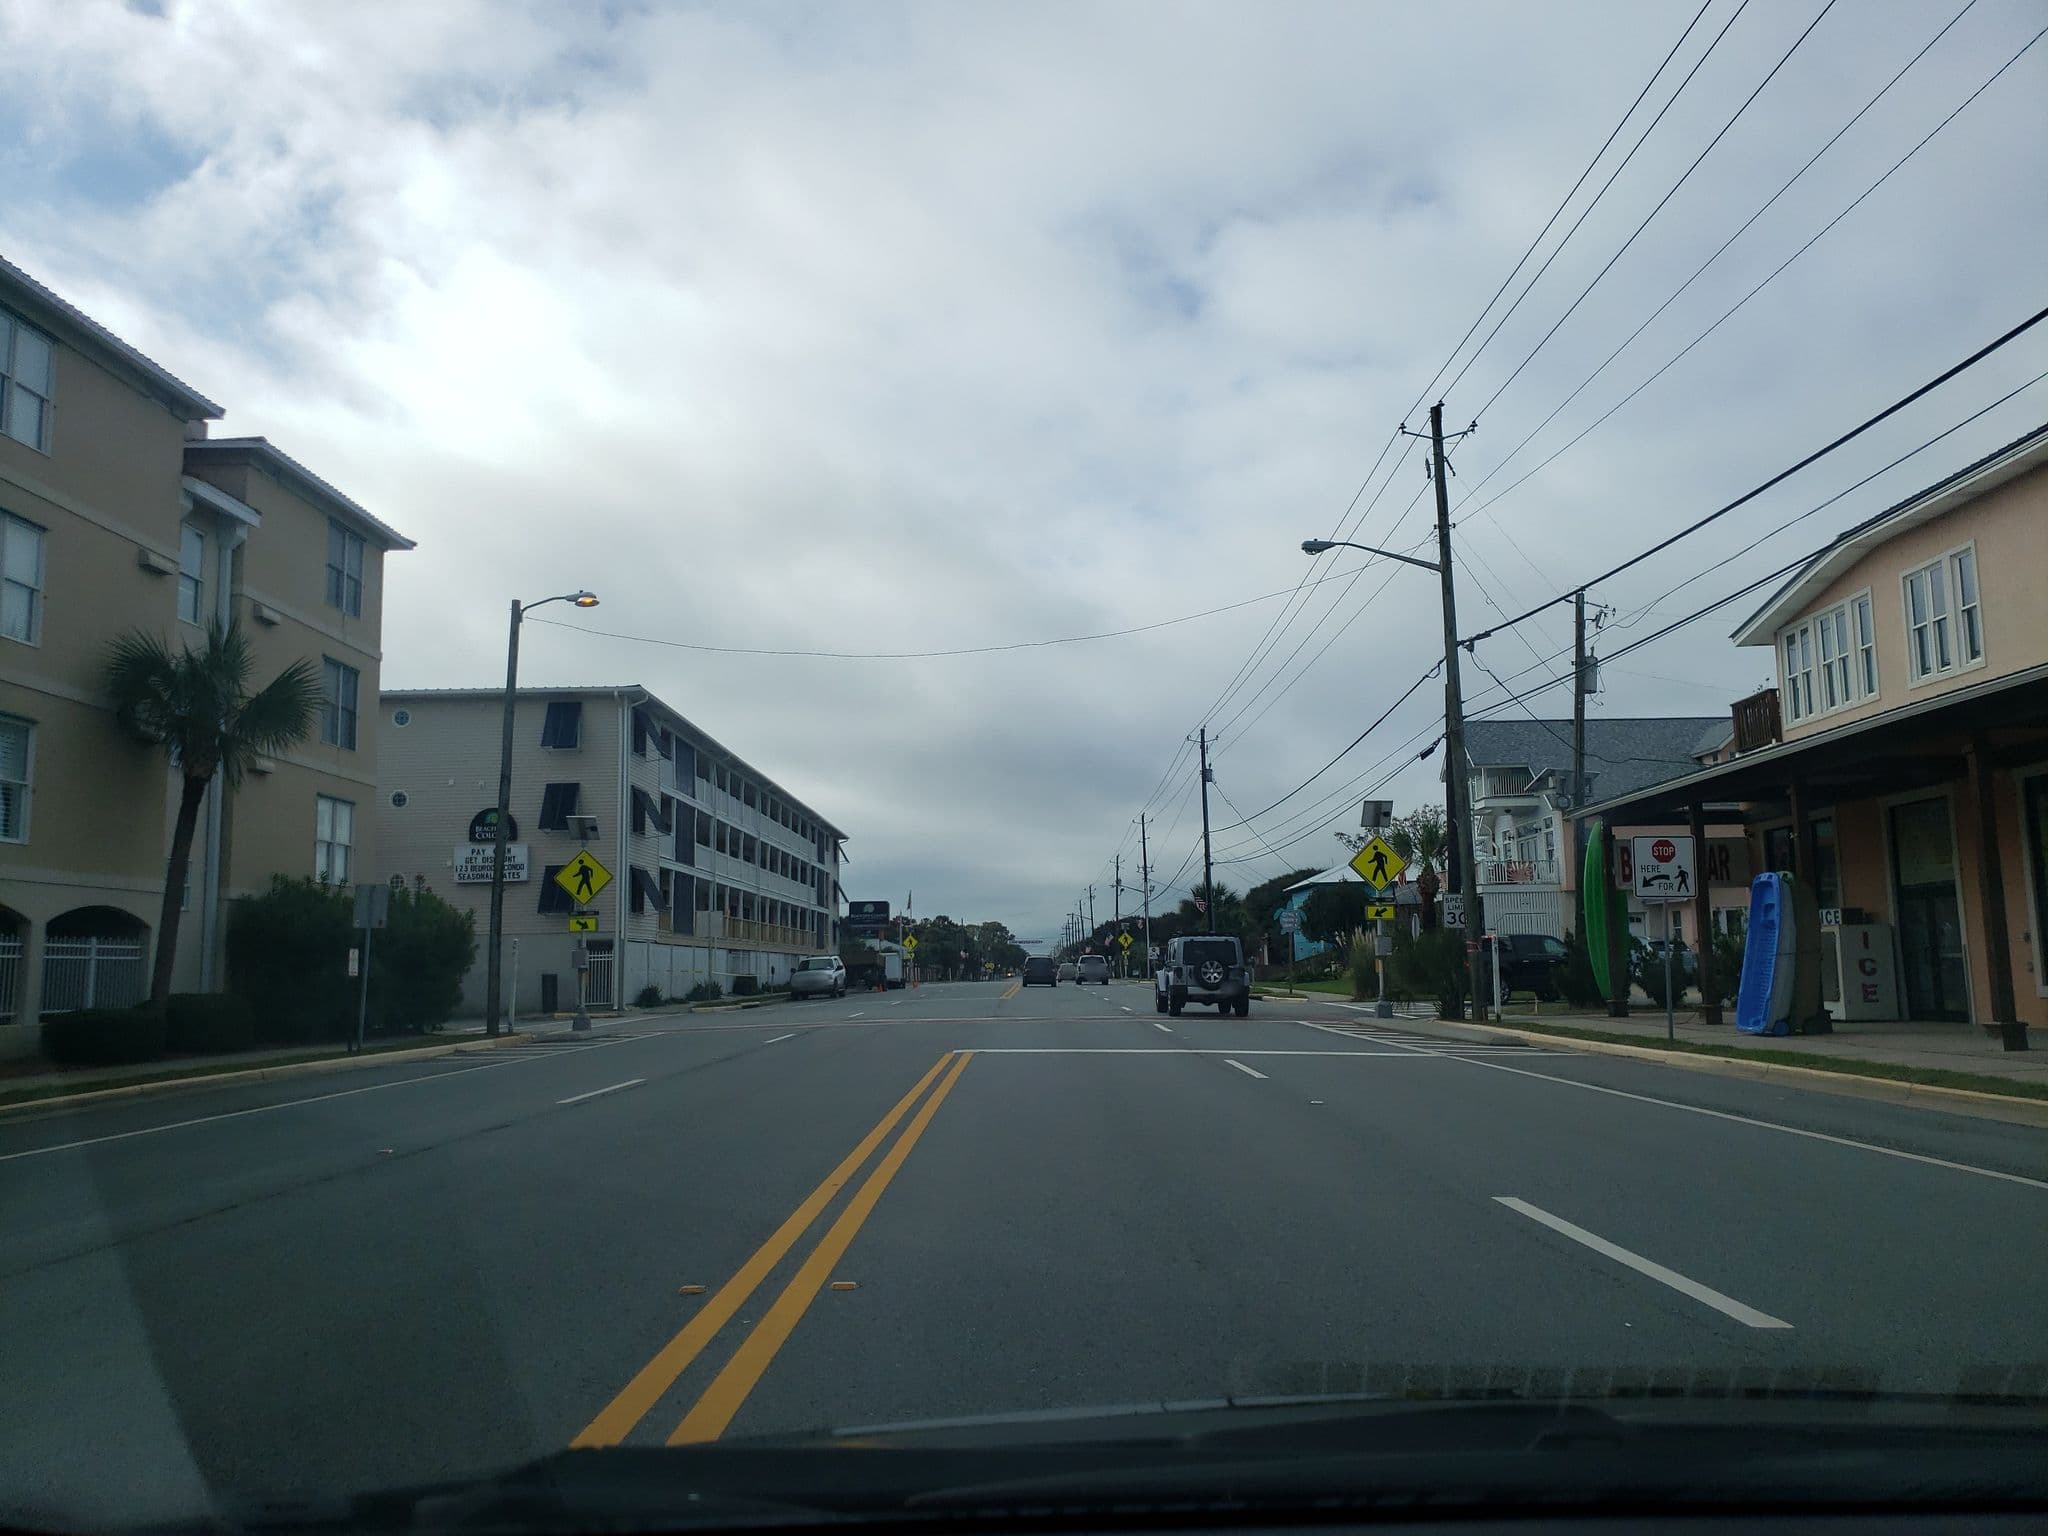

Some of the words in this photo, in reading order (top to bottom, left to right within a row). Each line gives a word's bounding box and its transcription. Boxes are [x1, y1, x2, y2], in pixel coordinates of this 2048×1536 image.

[471, 848, 486, 856] PAY
[1653, 846, 1675, 856] STOP
[1640, 864, 1661, 873] HERE
[458, 872, 494, 881] SEASONAL
[503, 871, 521, 880] ATES
[1658, 882, 1674, 891] FOR
[1820, 910, 1840, 924] ICE
[1858, 930, 1879, 1003] ICE
